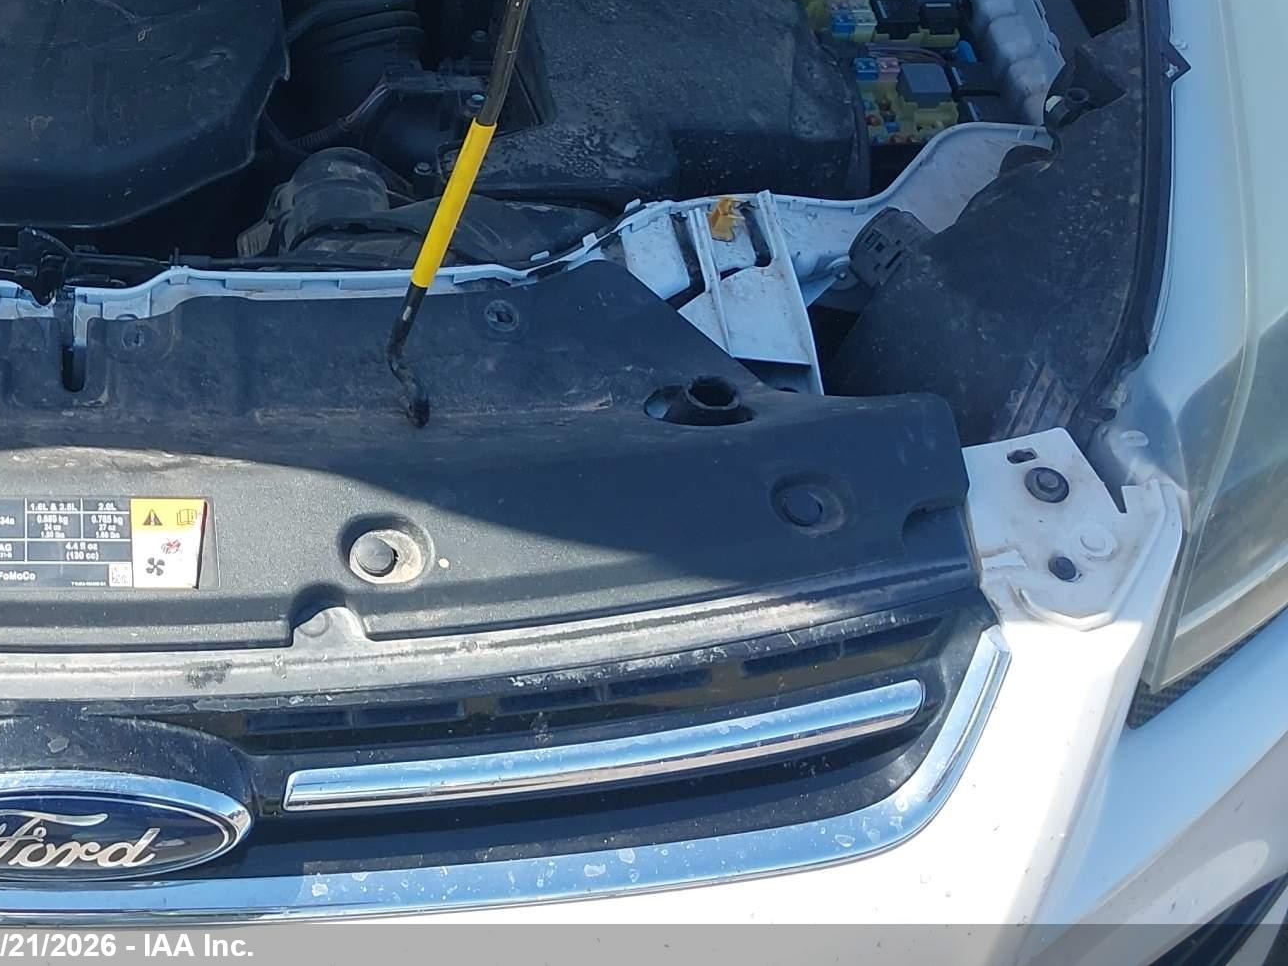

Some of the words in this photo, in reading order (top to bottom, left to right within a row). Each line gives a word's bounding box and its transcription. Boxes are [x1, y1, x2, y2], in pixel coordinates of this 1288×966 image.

[65, 542, 79, 551] 4.4
[87, 543, 98, 551] oz
[85, 551, 99, 561] cc)
